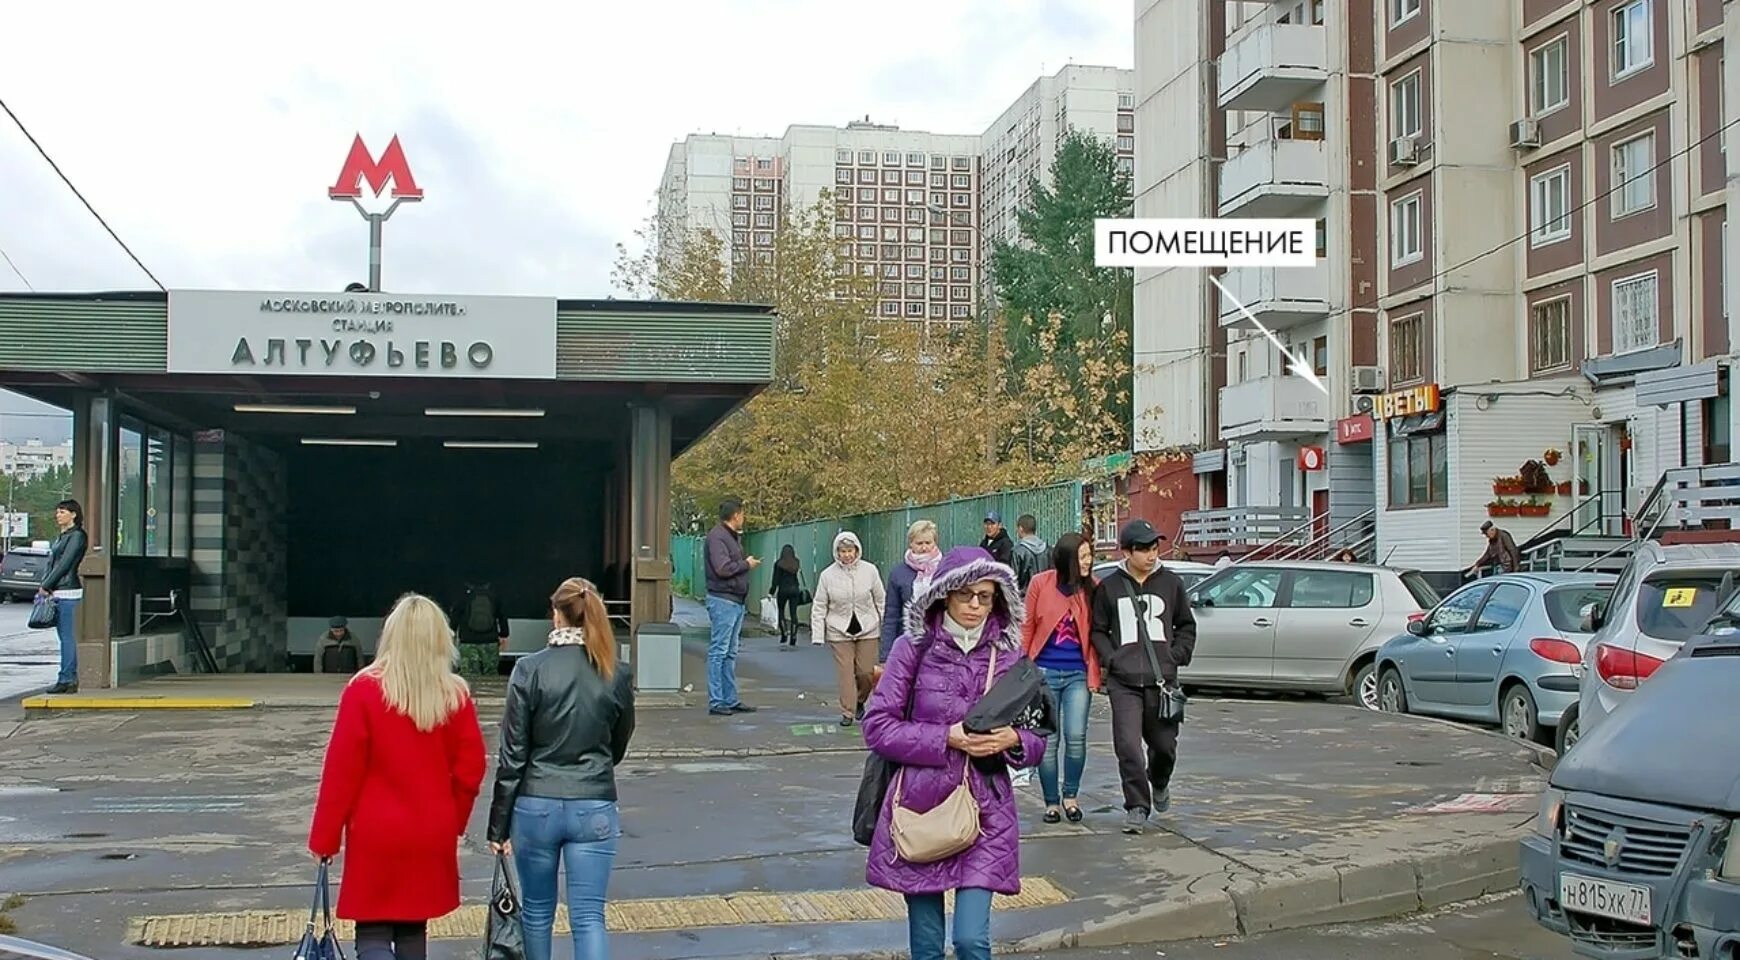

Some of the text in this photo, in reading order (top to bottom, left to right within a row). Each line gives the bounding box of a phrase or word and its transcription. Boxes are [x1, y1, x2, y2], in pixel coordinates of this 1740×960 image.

[328, 131, 423, 198] М
[260, 299, 356, 313] МОСКОВСКИЙ
[332, 319, 393, 334] СТАНЦИЯ
[231, 337, 494, 369] АЛТУФЬЕВО
[1373, 385, 1432, 423] ЦВЕТЫ
[1117, 593, 1167, 646] R
[1630, 889, 1644, 911] 77
